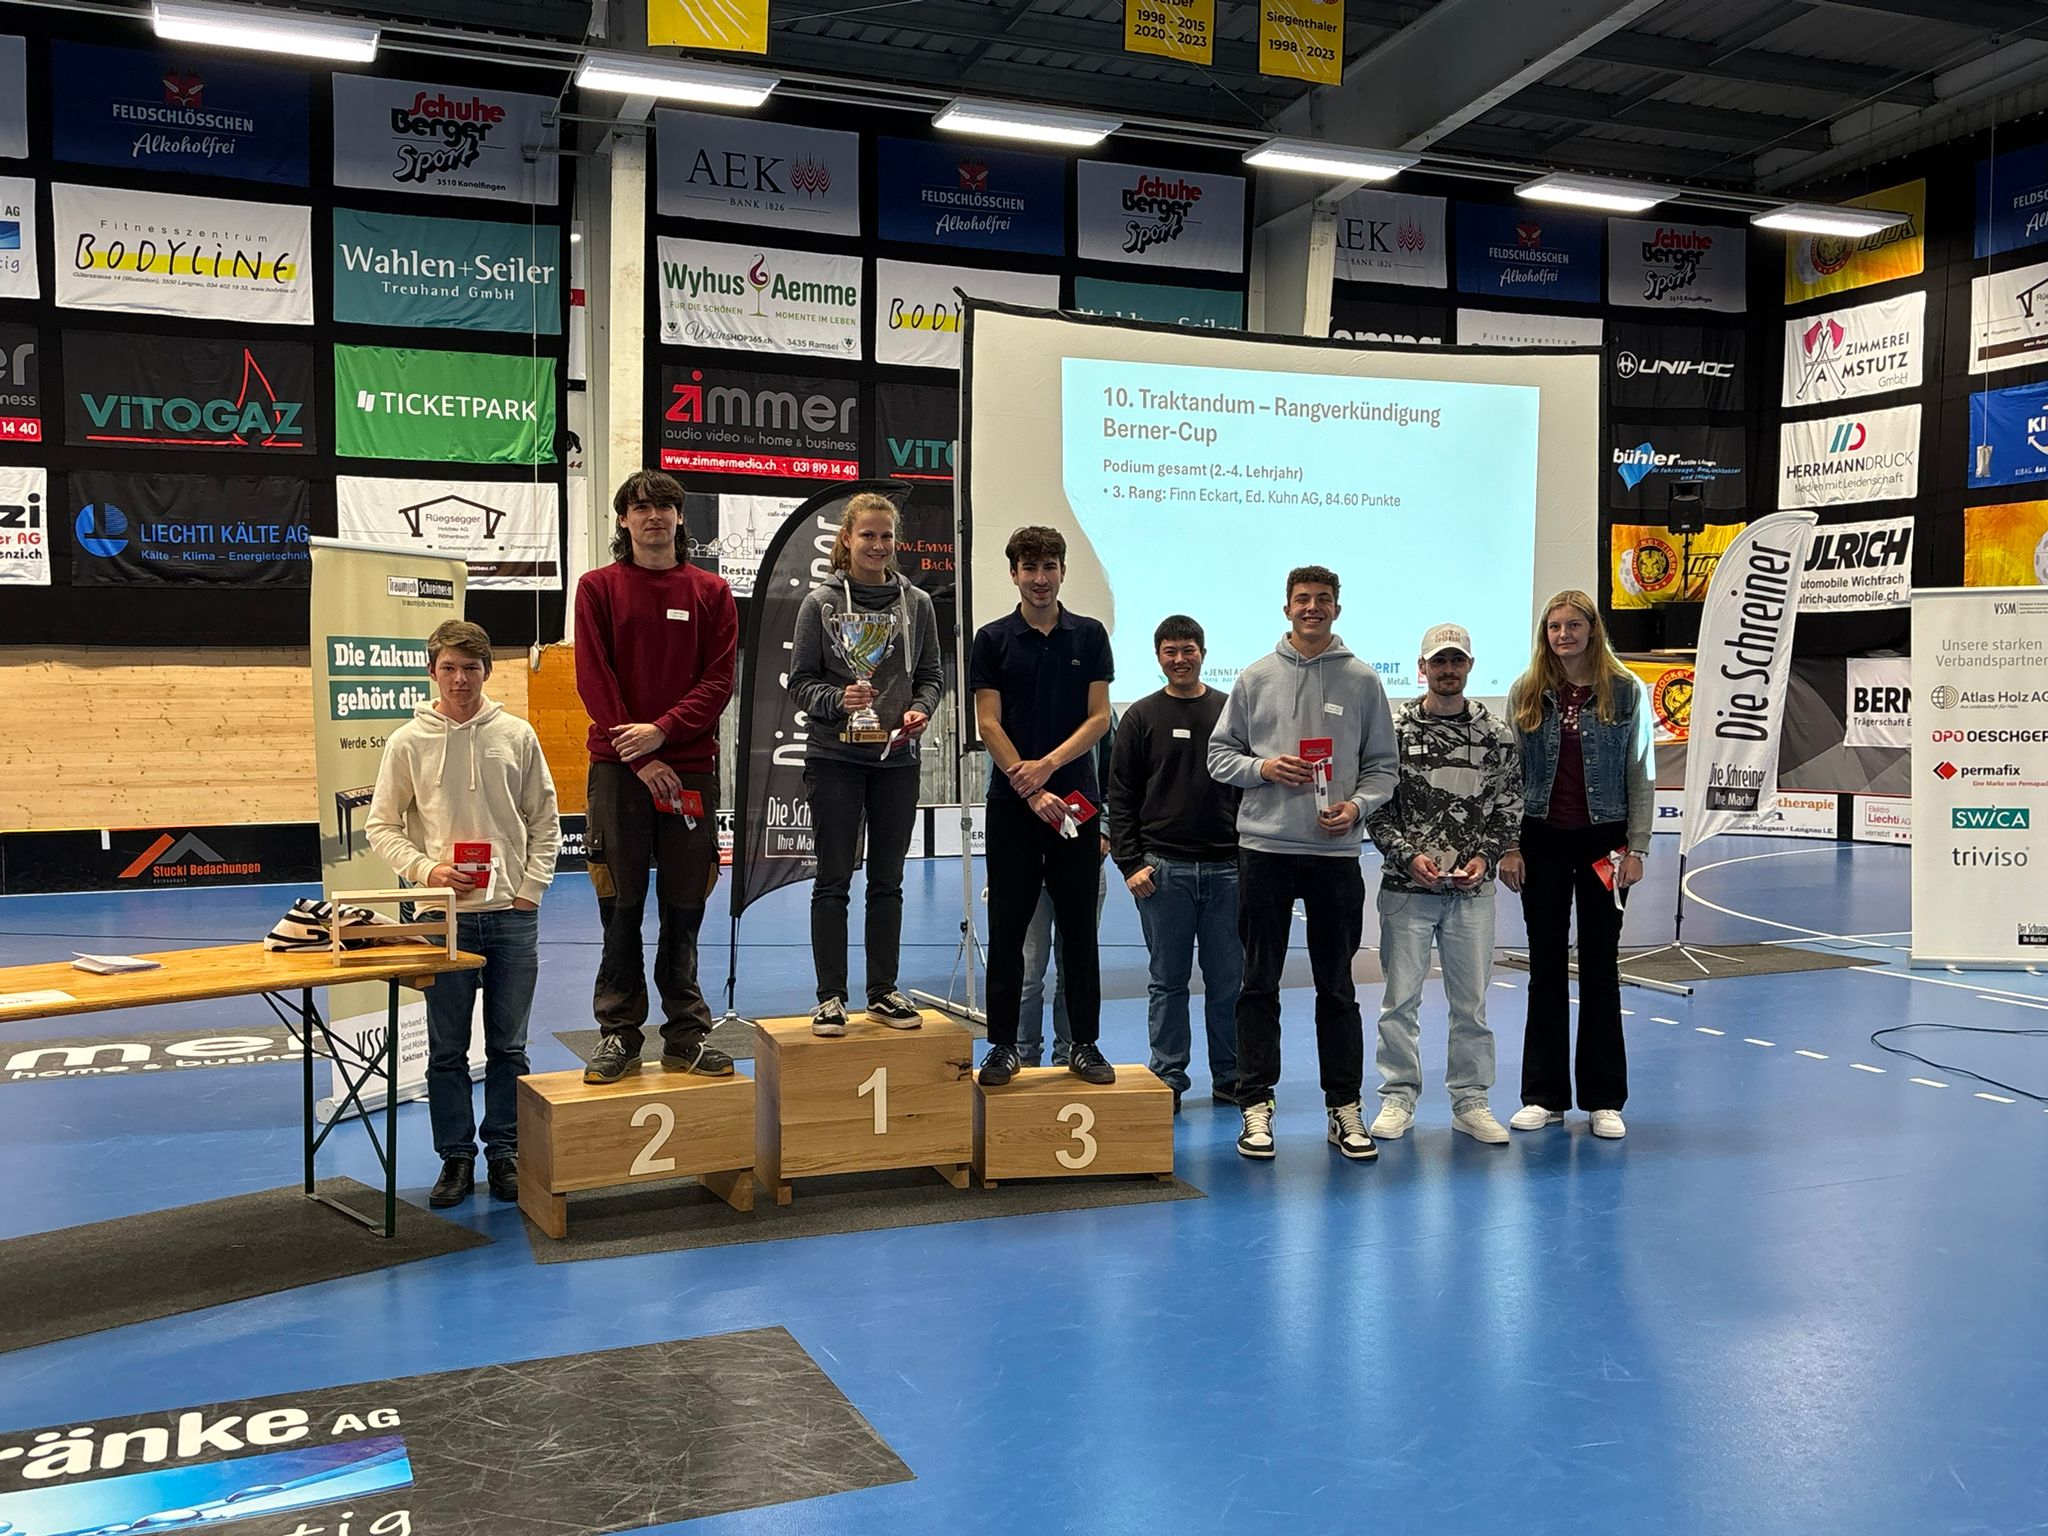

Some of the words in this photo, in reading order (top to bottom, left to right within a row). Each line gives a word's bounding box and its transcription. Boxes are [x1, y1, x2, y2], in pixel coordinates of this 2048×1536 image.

[1137, 9, 1166, 25] 1998
[1178, 17, 1206, 32] 2015
[1266, 11, 1338, 33] Siegenthaler
[1134, 25, 1166, 39] 2020
[1177, 32, 1207, 47] 2023
[1268, 39, 1297, 53] 1998
[1306, 46, 1336, 60] 2023
[112, 103, 254, 132] FELDSCHLÖSSCHEN
[408, 91, 506, 123] Schuhe
[391, 108, 494, 148] Berger
[132, 132, 236, 159] Alkoholfrei
[392, 137, 480, 183] Sport
[685, 148, 787, 195] AEK
[436, 179, 457, 188] 3510
[458, 180, 506, 191] Konolfingen
[1135, 174, 1202, 201] Schuhe
[5, 205, 20, 217] AG
[730, 197, 760, 209] BANK
[765, 202, 785, 212] 1826
[921, 189, 1025, 211] FELDSCHLÖSSCHEN
[1122, 189, 1193, 222] Berger
[100, 220, 268, 243] Fitnesszentrum
[935, 213, 1012, 236] Alkoholfrei
[1122, 215, 1184, 254] Sport
[1336, 218, 1393, 253] EK
[1652, 228, 1714, 250] Schuhe
[1350, 258, 1373, 267] BANK
[1488, 247, 1569, 265] FELDSCHLÖSSCHEN
[1641, 242, 1705, 270] Berger
[663, 261, 745, 298] Wyhus
[770, 273, 857, 307] Aemme
[1499, 267, 1559, 288] Alkoholfrei
[1642, 261, 1697, 300] Sport
[381, 280, 460, 298] Treuhand
[469, 286, 515, 301] GmbH
[687, 302, 702, 311] DIE
[703, 304, 743, 315] SCHÖNEN
[775, 311, 816, 322] MOMENTE
[818, 315, 828, 323] IM
[829, 316, 857, 326] LEBEN
[888, 297, 962, 333] BODY
[786, 338, 807, 347] 3435
[1482, 332, 1577, 345] Fitnesszentrum
[1845, 332, 1910, 356] ZIMMEREI
[1638, 359, 1735, 378] UNIHOC
[1878, 372, 1908, 388] GmbH
[380, 391, 537, 421] TICKETPARK
[665, 369, 857, 434] zimmer
[1103, 387, 1134, 408] 10.
[1138, 387, 1255, 415] Traktandum
[1274, 396, 1441, 428] Rangverkündigung
[1, 421, 15, 434] 14
[18, 421, 38, 435] 40
[665, 426, 702, 441] audio
[705, 429, 741, 443] video
[758, 432, 793, 447] home
[805, 436, 857, 451] business
[1103, 417, 1218, 447] Berner-Cup
[887, 437, 954, 468] ViT
[1612, 447, 1680, 466] bühler
[665, 455, 777, 472] www.zimmermedia.ch
[793, 461, 810, 473] 031
[812, 463, 828, 474] 819
[831, 465, 841, 475] 14
[842, 465, 857, 476] 40
[1103, 459, 1155, 475] Podium
[1157, 462, 1207, 477] gesamt
[1209, 464, 1243, 479] (2.-4.
[1246, 465, 1304, 482] Lehrjahr)
[1786, 450, 1914, 479] HERRMANNDRUCK
[1825, 480, 1842, 491] mit
[1843, 472, 1904, 488] Leidenschaft
[1112, 486, 1125, 499] 3.
[1128, 486, 1167, 502] Rang:
[1169, 487, 1198, 501] Finn
[1199, 488, 1242, 504] Eckart,
[1245, 490, 1265, 504] Ed.
[1268, 491, 1299, 504] Kuhn
[1301, 492, 1323, 506] AG,
[1325, 492, 1359, 506] 84.60
[1361, 493, 1401, 507] Punkte
[425, 513, 481, 524] Rüegsegger
[17, 532, 42, 545] AG
[140, 524, 214, 544] LIECHTI
[221, 521, 280, 544] KÄLTE
[284, 524, 310, 544] AG
[141, 550, 170, 561] Kälte
[182, 550, 216, 561] Klima
[228, 551, 309, 563] Energietechnik
[721, 565, 759, 577] Restau
[1801, 578, 1849, 589] utomobile
[1851, 573, 1905, 587] Wichtrach
[1720, 540, 1791, 686] Schreiner
[1994, 602, 2017, 615] VSSM
[333, 641, 366, 667] Die
[369, 644, 429, 668] Zukun
[1942, 639, 1988, 651] Unsere
[1992, 637, 2042, 651] starken
[1936, 654, 2048, 669] Verbandspartner
[336, 686, 396, 717] gehört
[1960, 691, 1995, 703] Atlas
[1998, 691, 2029, 703] Holz
[2031, 691, 2048, 702] AG
[1715, 693, 1769, 741] Die
[1853, 716, 1905, 727] Trägerschaft
[340, 736, 367, 749] Werde
[1932, 730, 1964, 742] OPO
[1961, 764, 2020, 778] permafix
[767, 796, 788, 826] Die
[790, 797, 812, 826] Sch
[1776, 797, 1835, 813] therapie
[1868, 813, 1899, 825] Liechti
[777, 833, 795, 851] Ihre
[1952, 846, 2028, 867] triviso
[190, 862, 261, 876] Bedachungen
[12, 1065, 129, 1080] home
[857, 1066, 888, 1135] 1
[628, 1102, 676, 1176] 2
[1054, 1102, 1098, 1170] 3
[331, 1407, 401, 1436] AG
